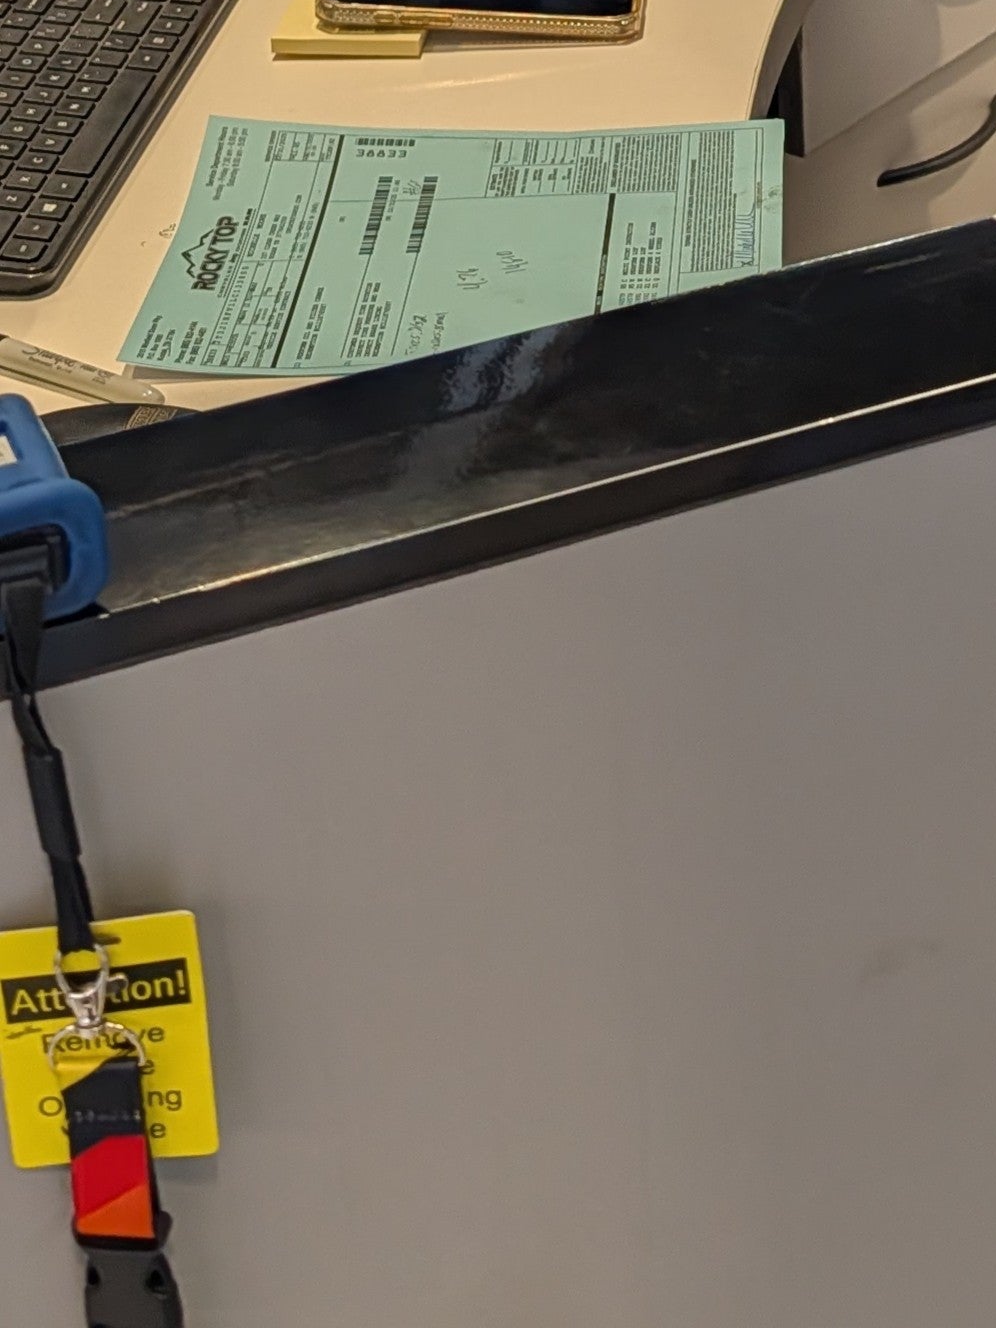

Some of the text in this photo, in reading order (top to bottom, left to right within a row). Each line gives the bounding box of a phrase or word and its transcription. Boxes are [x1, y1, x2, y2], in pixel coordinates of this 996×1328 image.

[210, 216, 239, 245] TOP
[243, 208, 253, 226] RAM
[192, 249, 229, 290] ROCKY
[11, 969, 187, 1015] Atttion!
